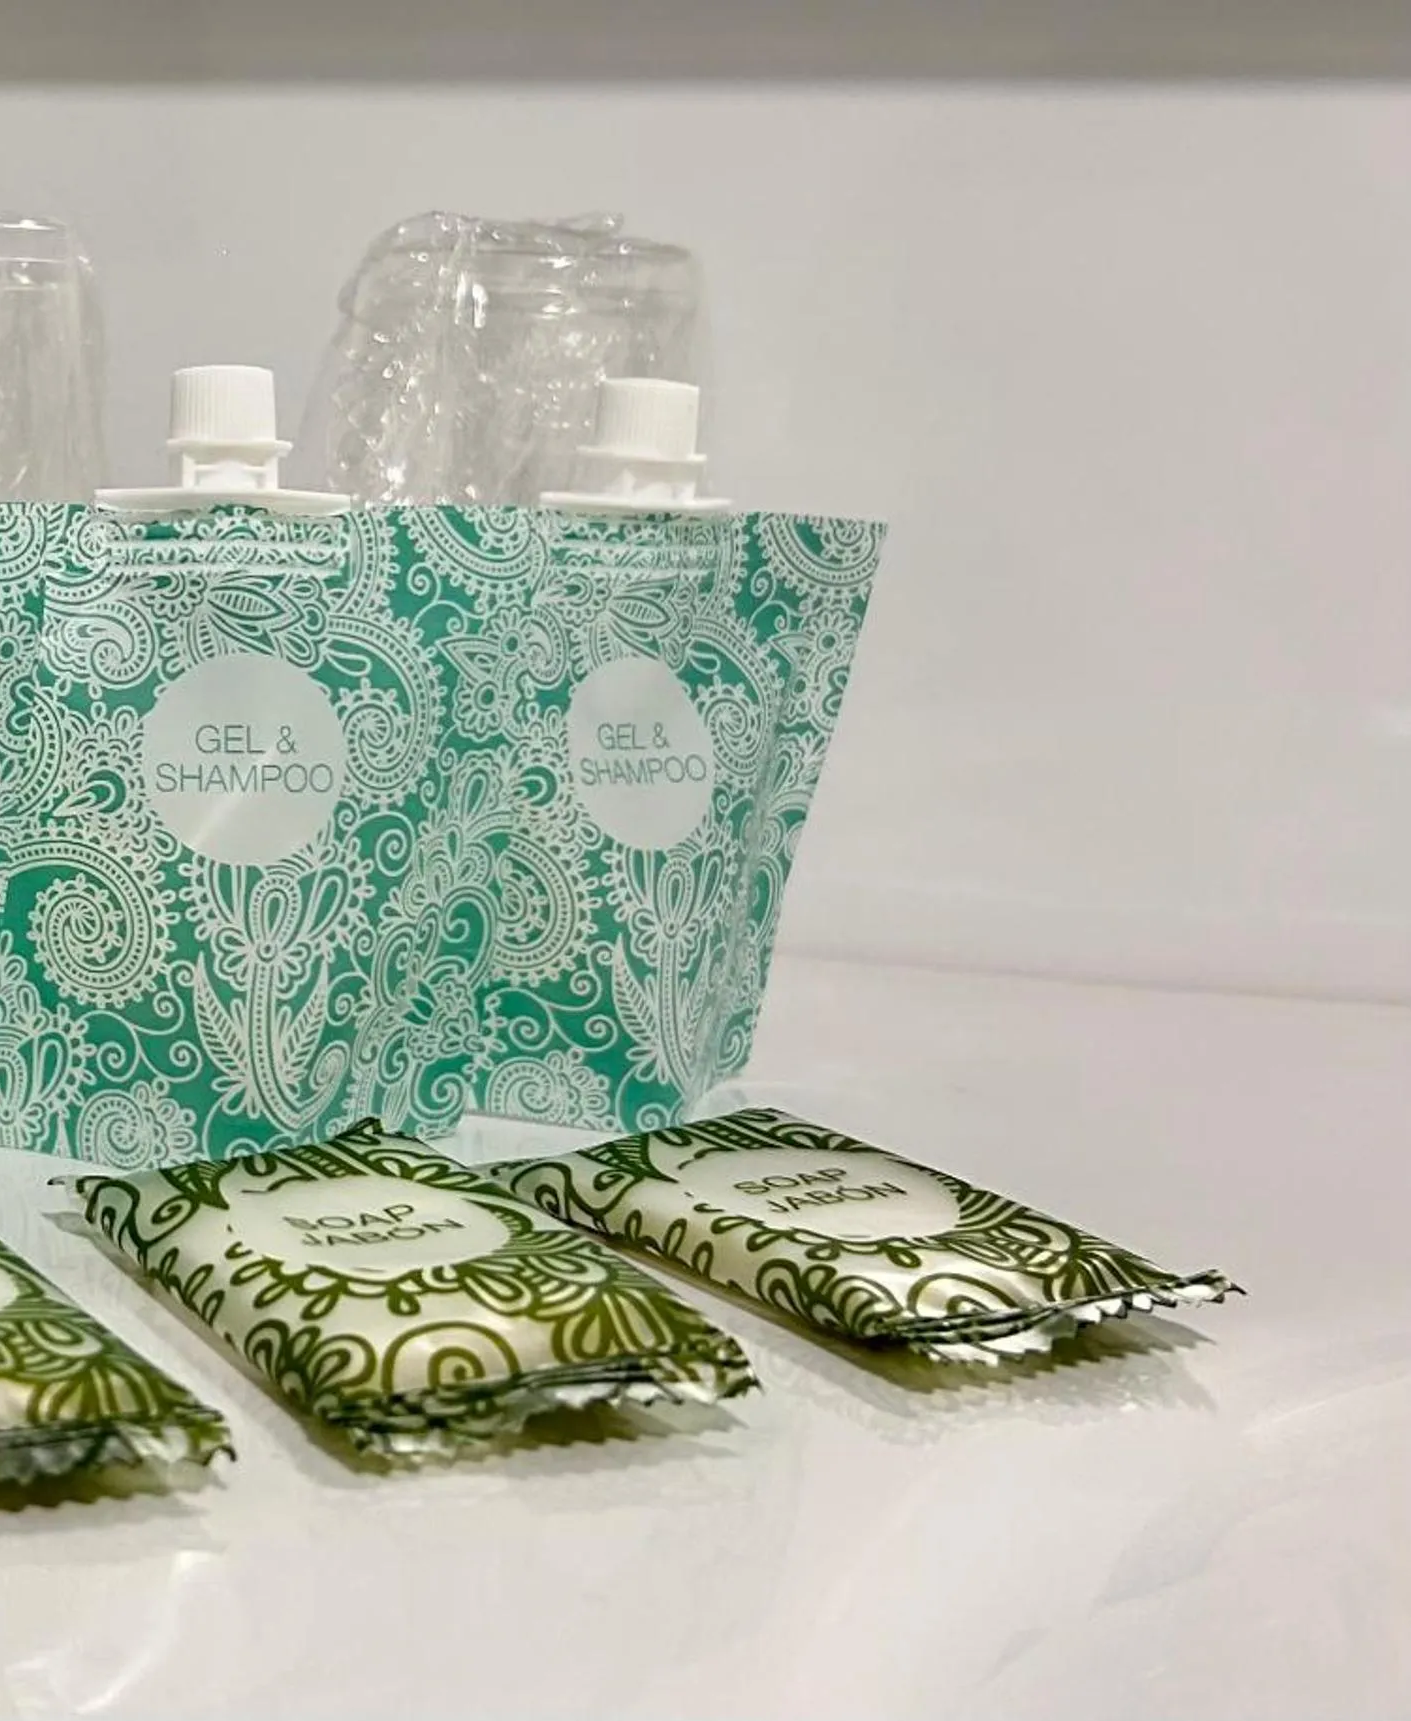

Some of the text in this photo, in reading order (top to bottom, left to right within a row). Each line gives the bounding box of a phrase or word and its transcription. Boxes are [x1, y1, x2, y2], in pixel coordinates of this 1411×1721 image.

[195, 724, 298, 754] GEL &
[597, 722, 670, 750] GEL &
[155, 763, 334, 793] SHAMPOO
[580, 754, 707, 786] SHAMPOO
[733, 1167, 847, 1195] SOAP
[282, 1204, 415, 1231] SOAP
